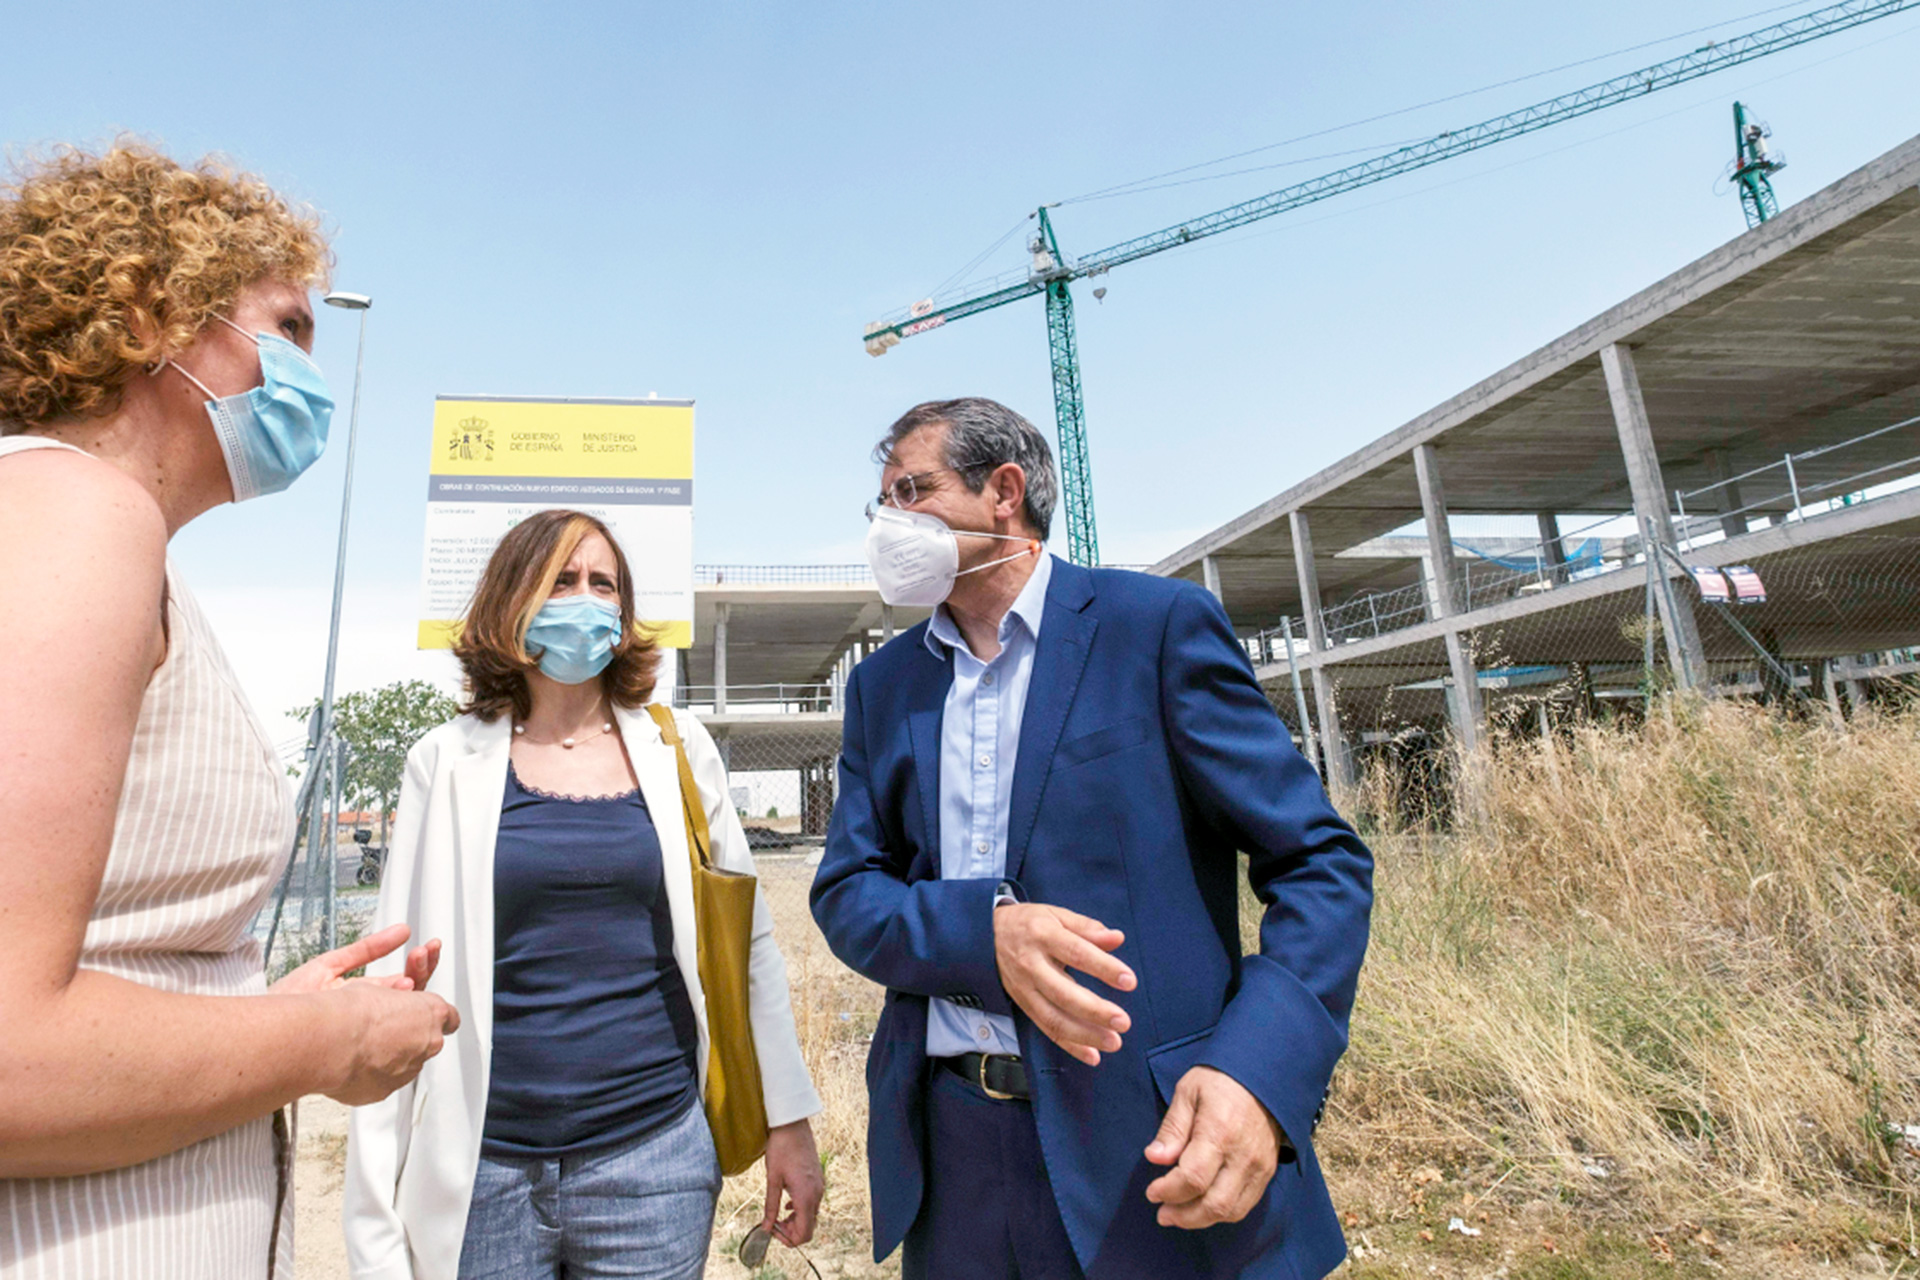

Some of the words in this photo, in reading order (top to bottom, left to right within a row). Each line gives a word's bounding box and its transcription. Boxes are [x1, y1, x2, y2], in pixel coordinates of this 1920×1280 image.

[511, 432, 560, 441] GOBIERNO
[582, 432, 636, 442] MINISTERIO
[510, 442, 523, 451] DE
[525, 441, 564, 452] ESPAÑA
[582, 443, 595, 452] DE
[597, 444, 638, 453] JUSTICIA
